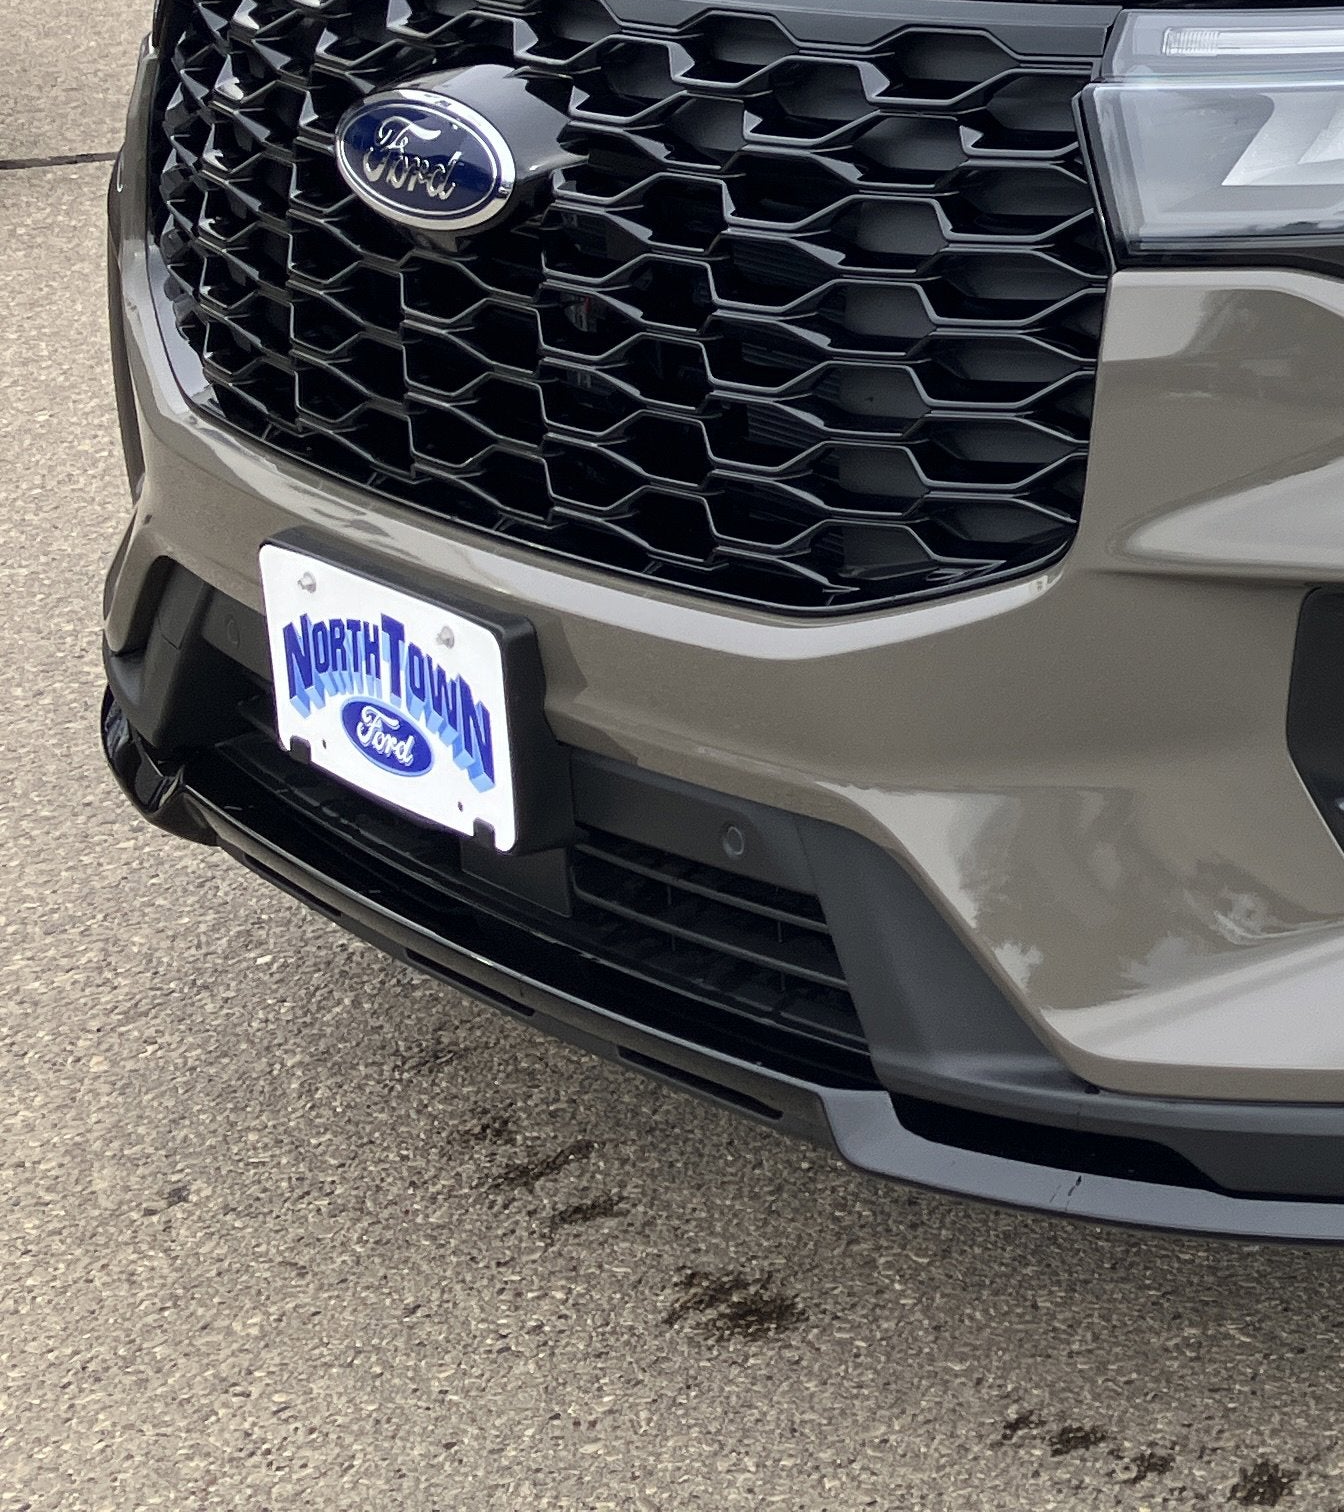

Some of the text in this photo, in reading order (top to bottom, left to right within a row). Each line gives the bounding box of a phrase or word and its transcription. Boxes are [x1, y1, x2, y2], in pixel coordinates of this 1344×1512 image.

[362, 115, 463, 201] Ford
[282, 612, 496, 791] NORTHTOWN
[356, 705, 416, 766] Ford
